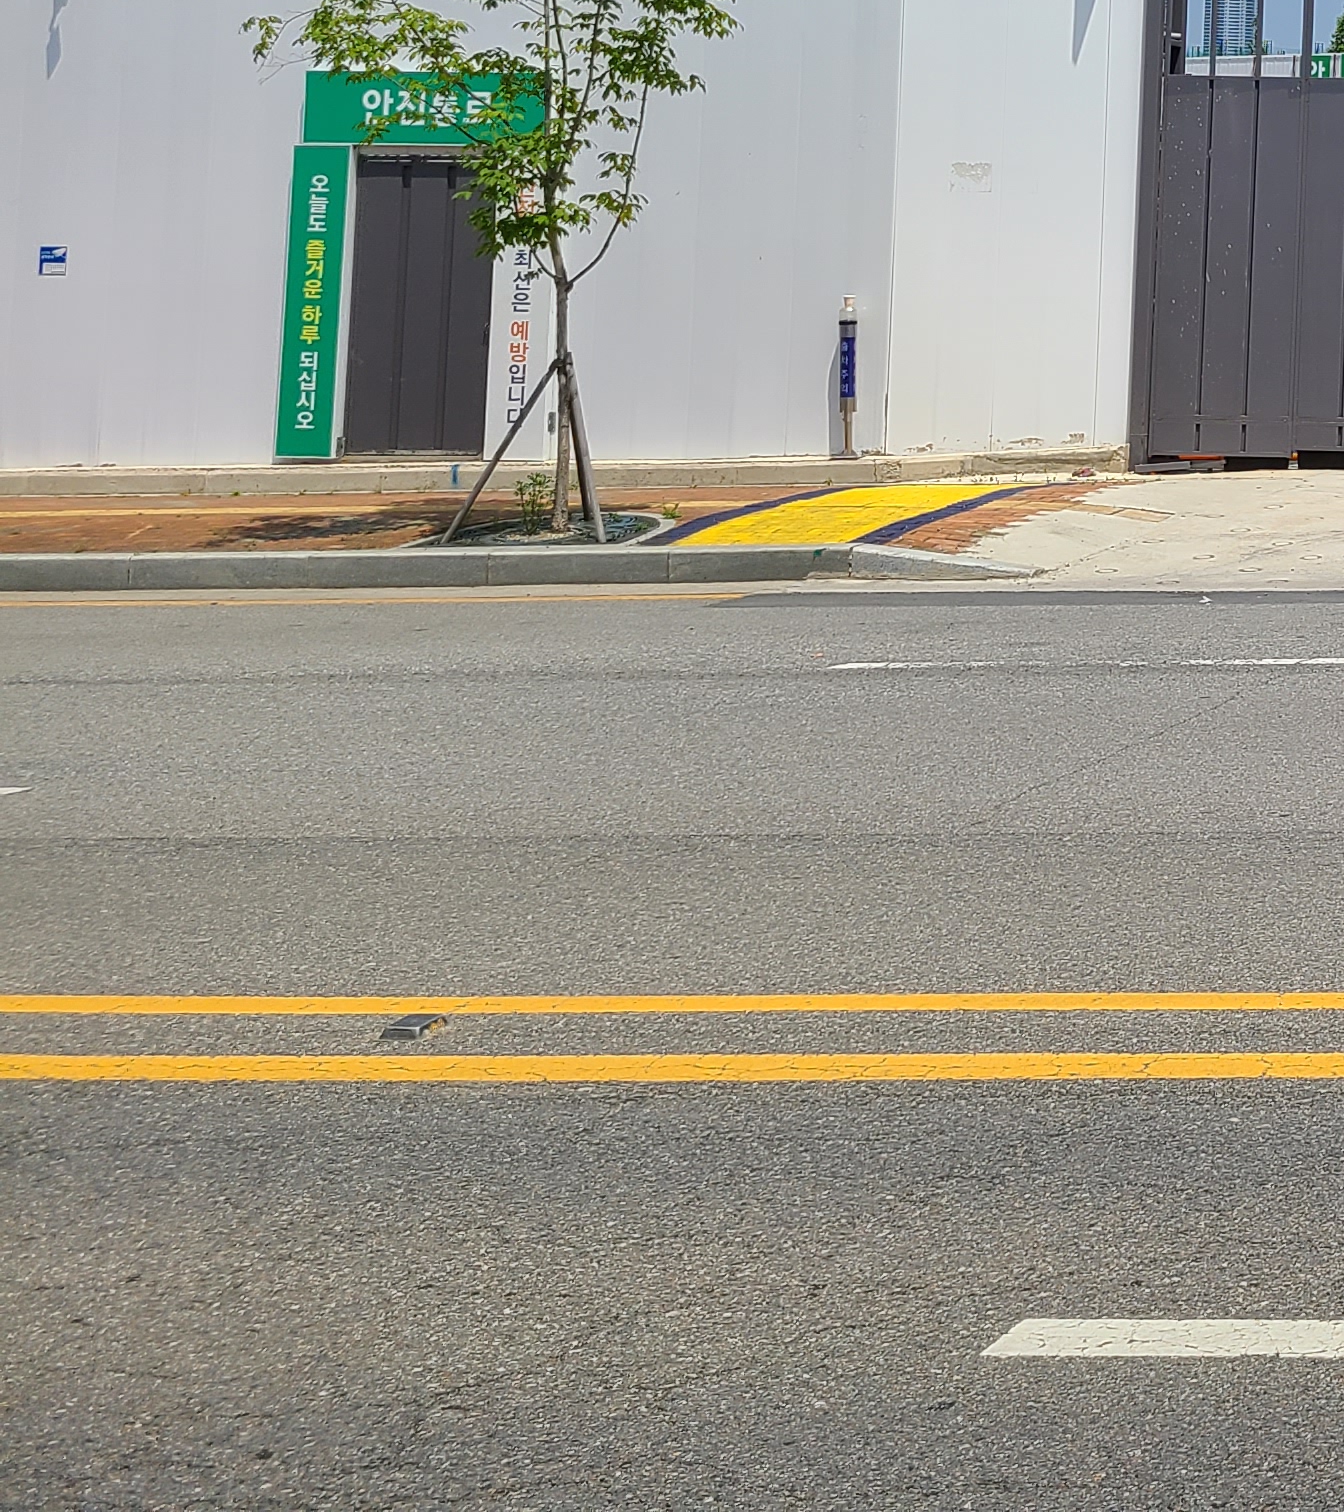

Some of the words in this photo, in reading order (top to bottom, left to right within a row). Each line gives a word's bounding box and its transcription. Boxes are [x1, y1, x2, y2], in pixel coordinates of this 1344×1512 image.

[307, 174, 330, 232] 오늘도
[302, 239, 326, 299] 즐거운
[300, 305, 323, 345] 하루
[294, 351, 319, 430] 되십시오
